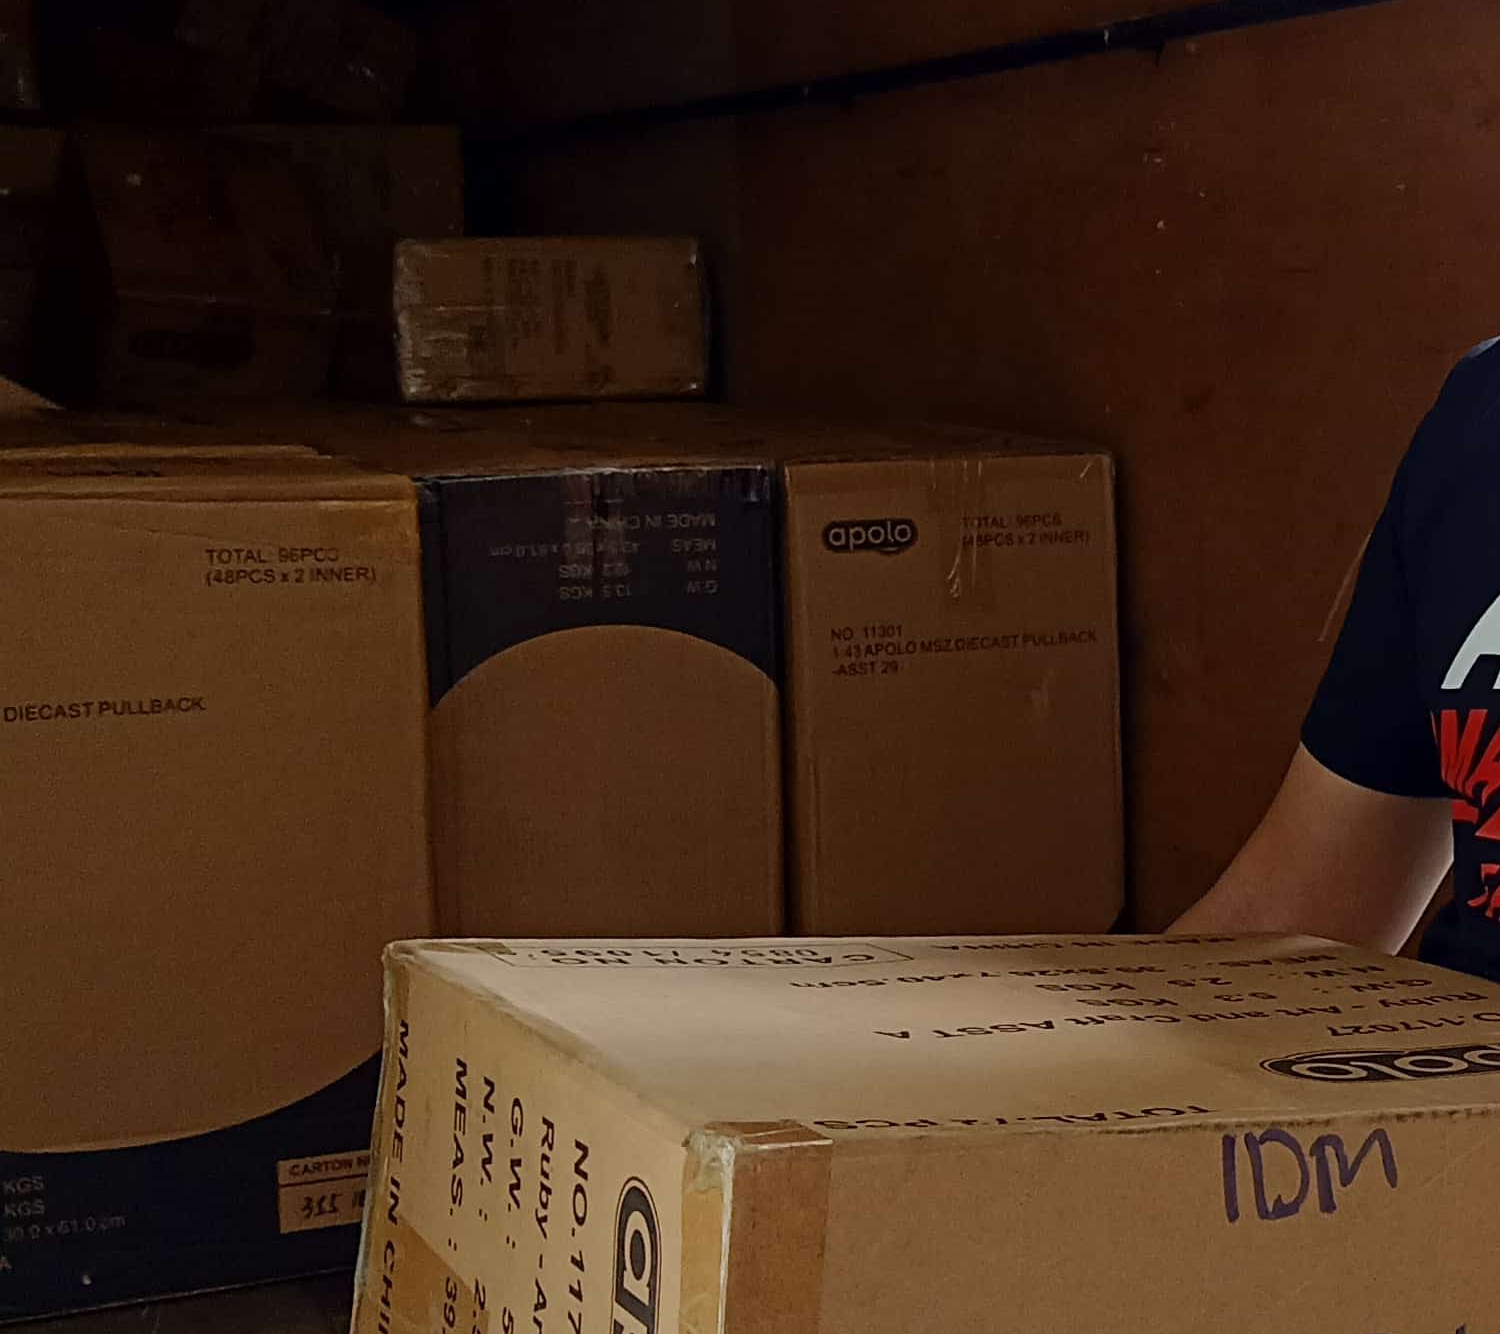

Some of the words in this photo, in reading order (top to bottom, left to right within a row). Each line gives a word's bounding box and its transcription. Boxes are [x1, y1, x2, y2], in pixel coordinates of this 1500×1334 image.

[825, 518, 914, 551] apolo
[205, 568, 276, 588] (48PCS
[294, 569, 305, 584] 2
[3, 700, 94, 722] DIECAST
[98, 696, 207, 716] PULLBACK
[654, 954, 875, 966] CARTON
[1035, 982, 1137, 992] KGS
[1076, 997, 1179, 1007] KGS
[1378, 992, 1489, 1009] Ruby
[1063, 1014, 1181, 1026] Craft
[1188, 1011, 1270, 1022] and
[1274, 1005, 1343, 1017] Art
[872, 1029, 911, 1040] A
[932, 1019, 1056, 1039] ASST
[391, 1019, 409, 1163] MADE
[480, 1076, 496, 1187] N.W.
[813, 1118, 939, 1130] PCS
[507, 1097, 524, 1212] G.W.
[289, 1159, 353, 1176] CARTON
[1220, 1127, 1398, 1224] IDM
[2, 1175, 46, 1196] KGS
[535, 1116, 555, 1240] Ruby
[2, 1198, 46, 1220] KGS
[387, 1176, 401, 1226] IN
